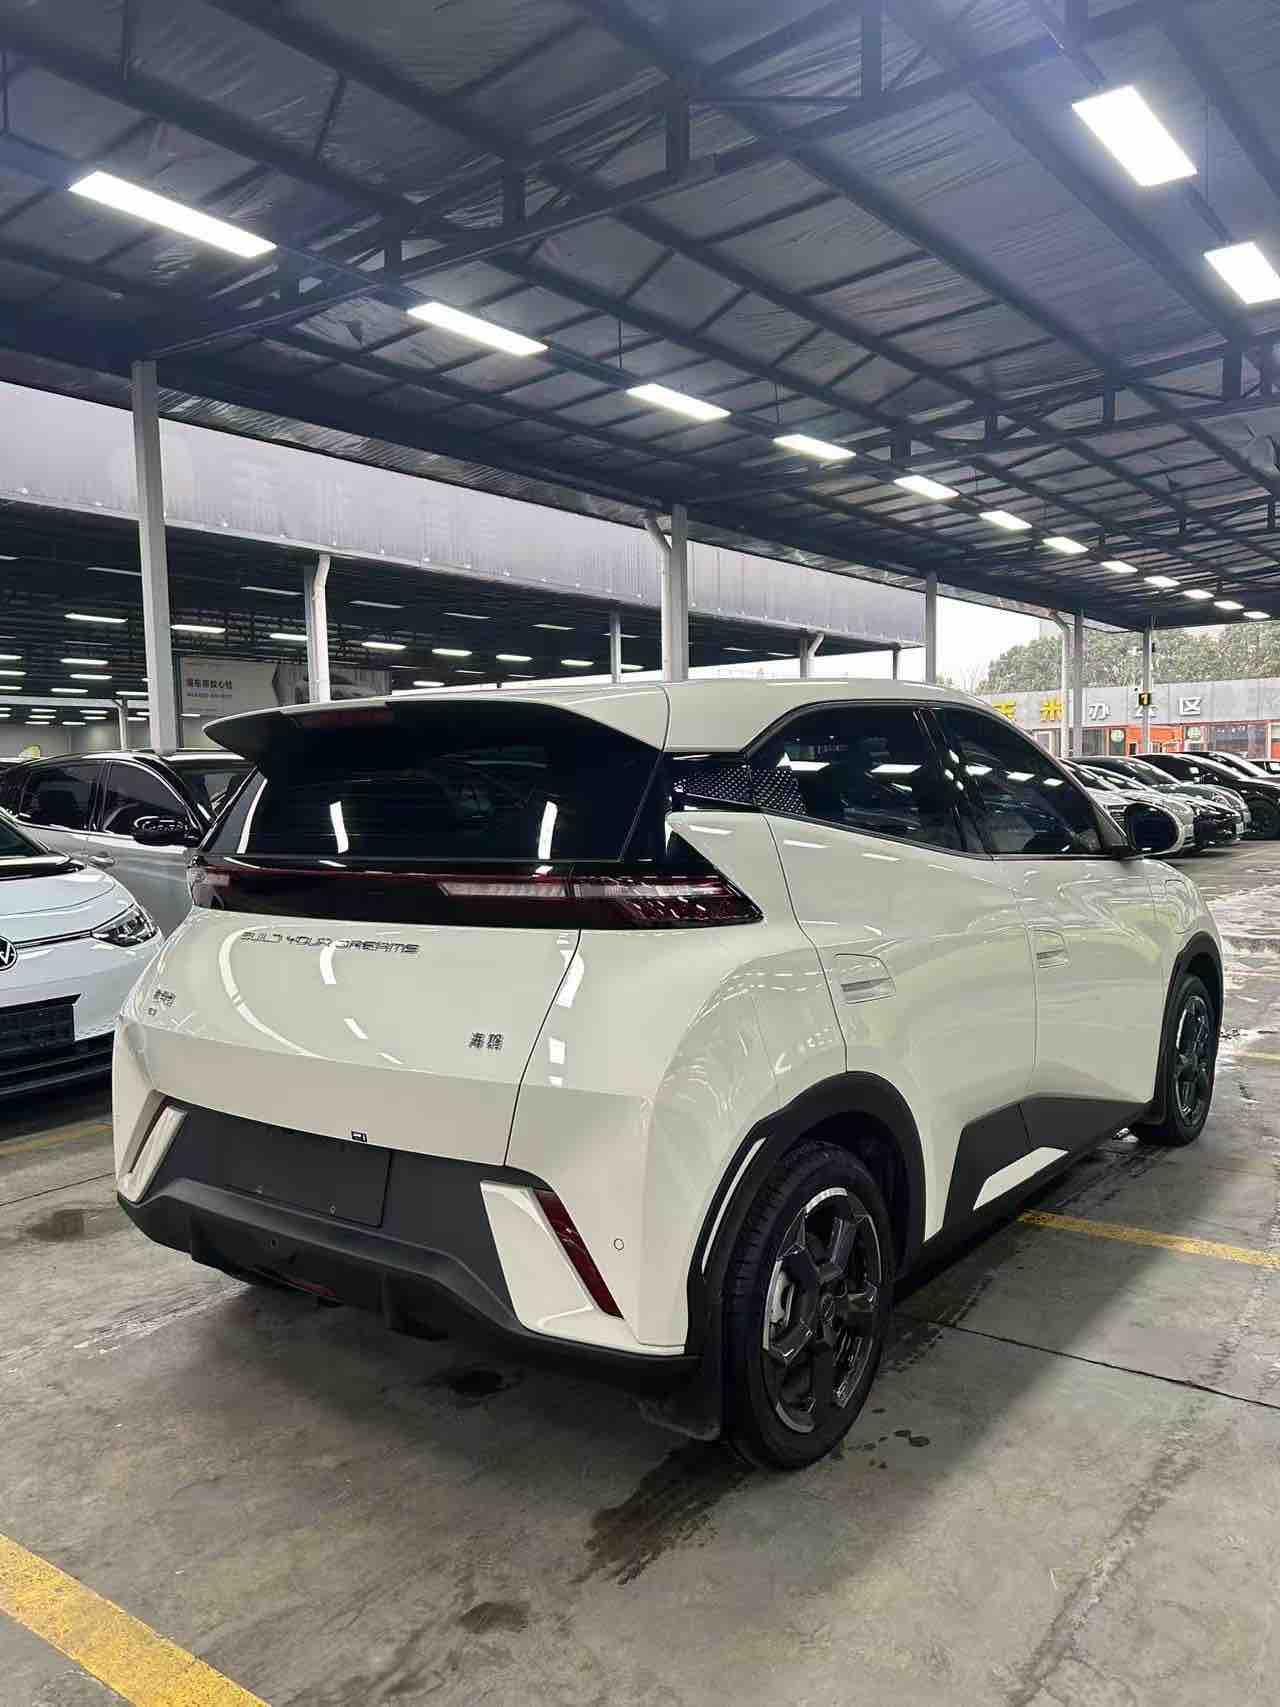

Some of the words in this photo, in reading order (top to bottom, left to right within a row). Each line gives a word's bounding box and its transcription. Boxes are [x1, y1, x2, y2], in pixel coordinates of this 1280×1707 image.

[240, 931, 283, 944] BUILD
[286, 935, 332, 948] YOUR
[334, 939, 420, 953] DREAMS
